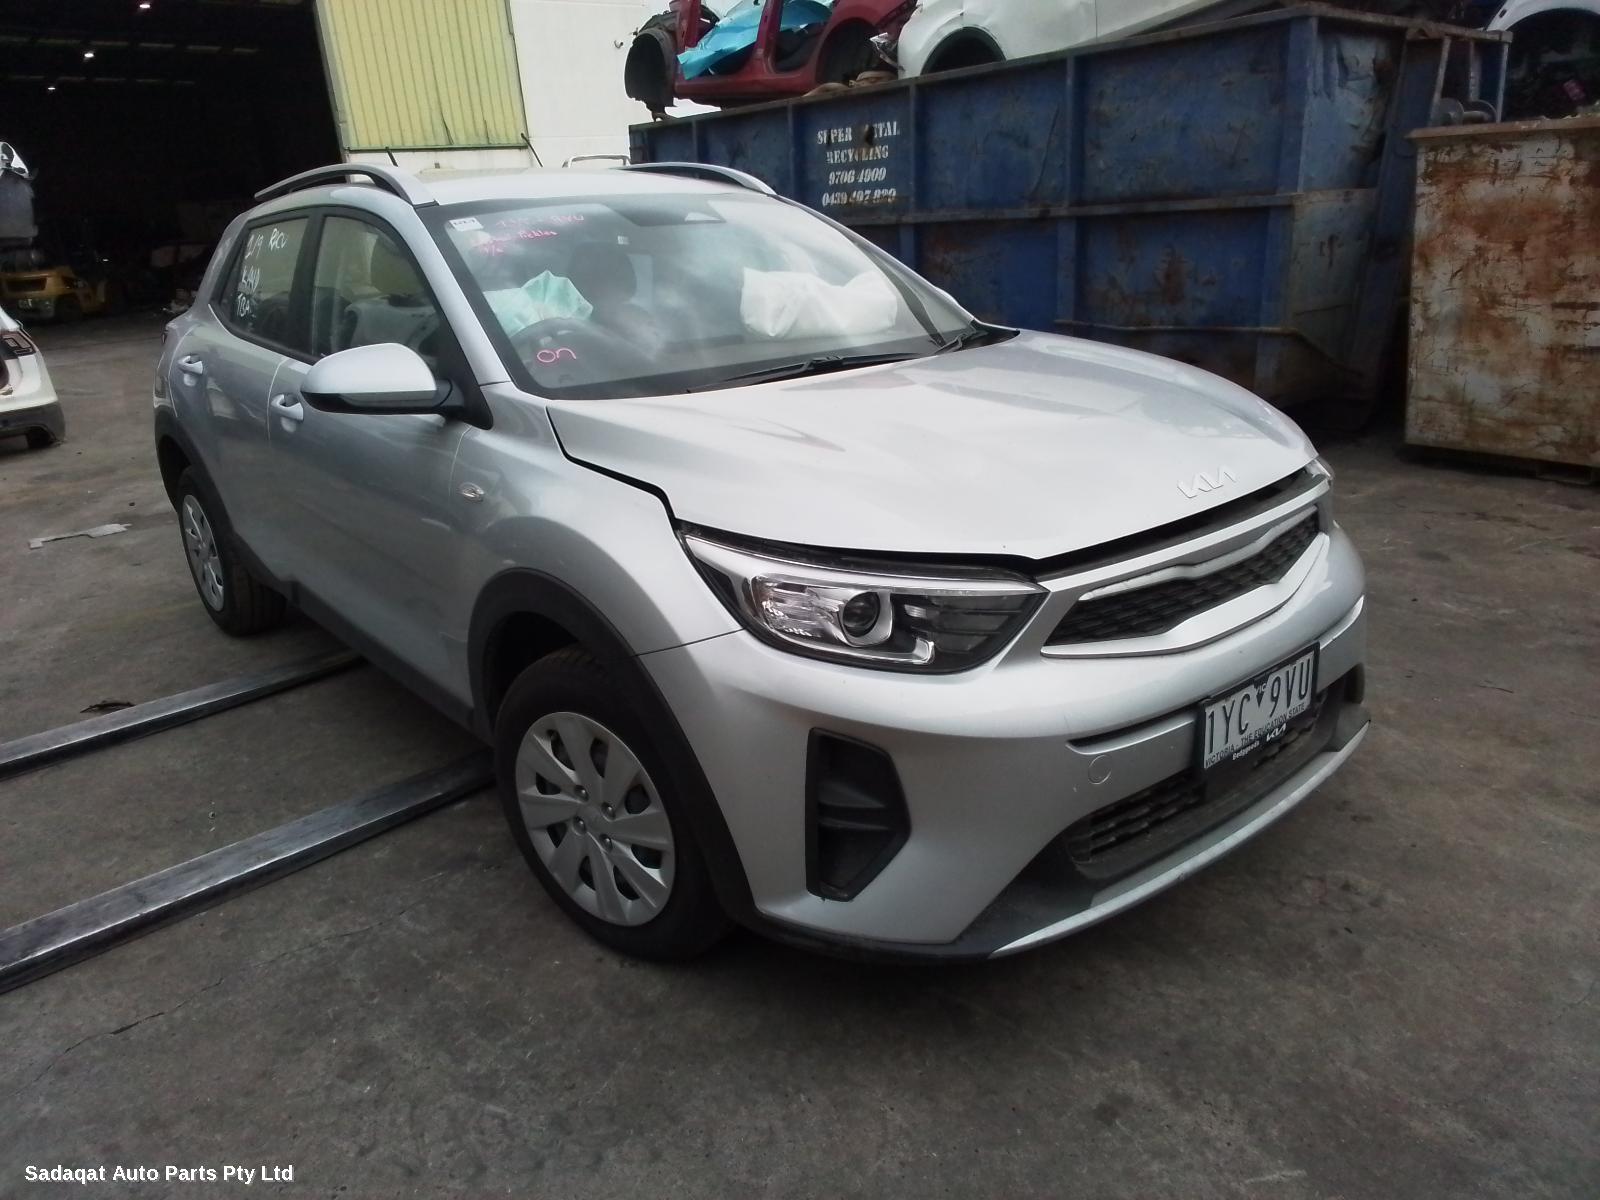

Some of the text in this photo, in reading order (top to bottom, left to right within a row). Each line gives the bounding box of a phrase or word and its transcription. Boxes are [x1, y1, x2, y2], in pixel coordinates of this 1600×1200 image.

[1208, 658, 1312, 756] 1YC 9VU
[1288, 702, 1306, 719] STATE
